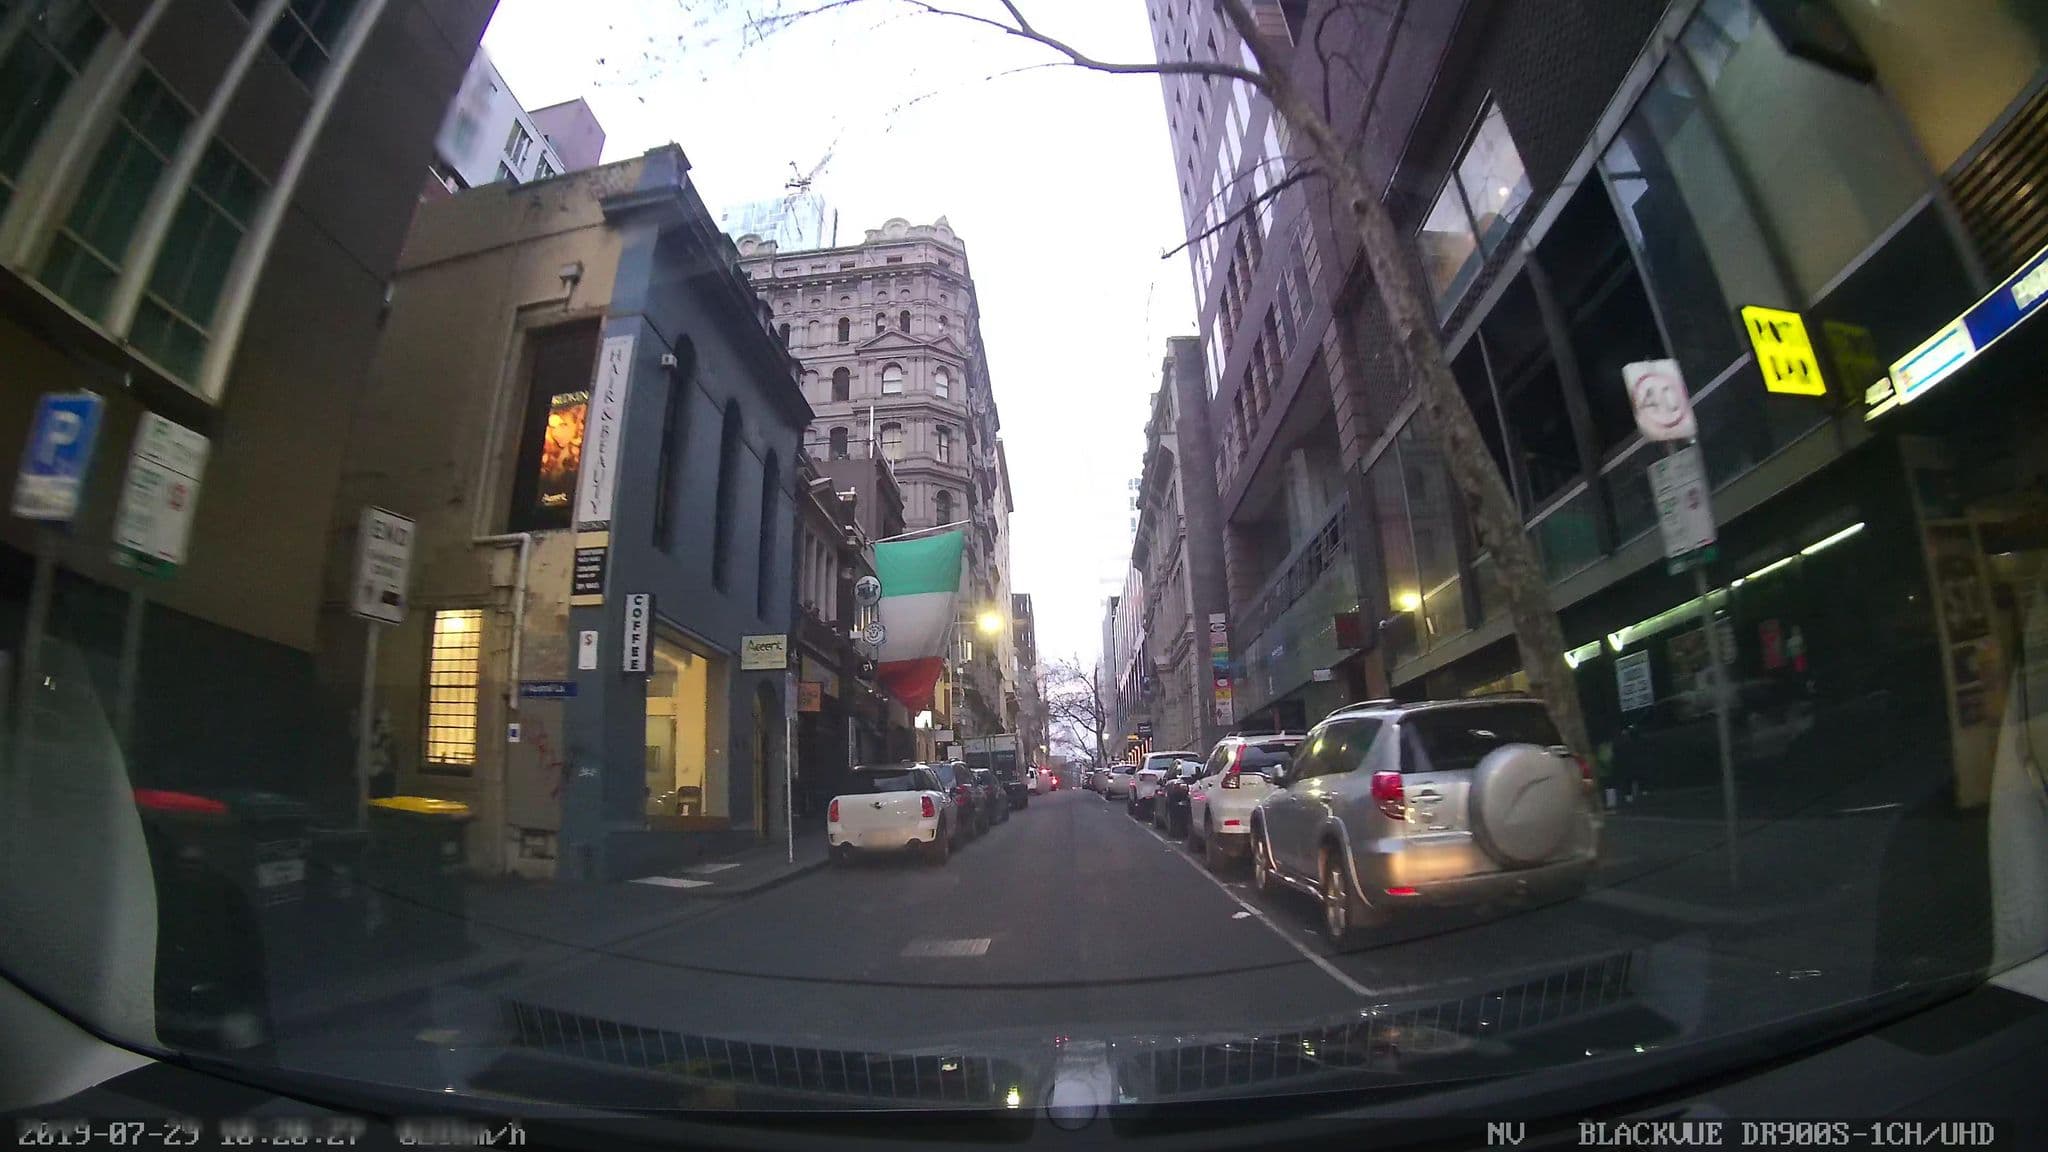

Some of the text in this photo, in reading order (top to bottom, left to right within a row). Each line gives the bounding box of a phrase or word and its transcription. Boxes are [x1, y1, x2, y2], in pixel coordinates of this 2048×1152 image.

[1641, 382, 1679, 413] 40
[38, 409, 82, 465] P
[367, 518, 408, 547] END
[630, 595, 644, 670] COFFEE
